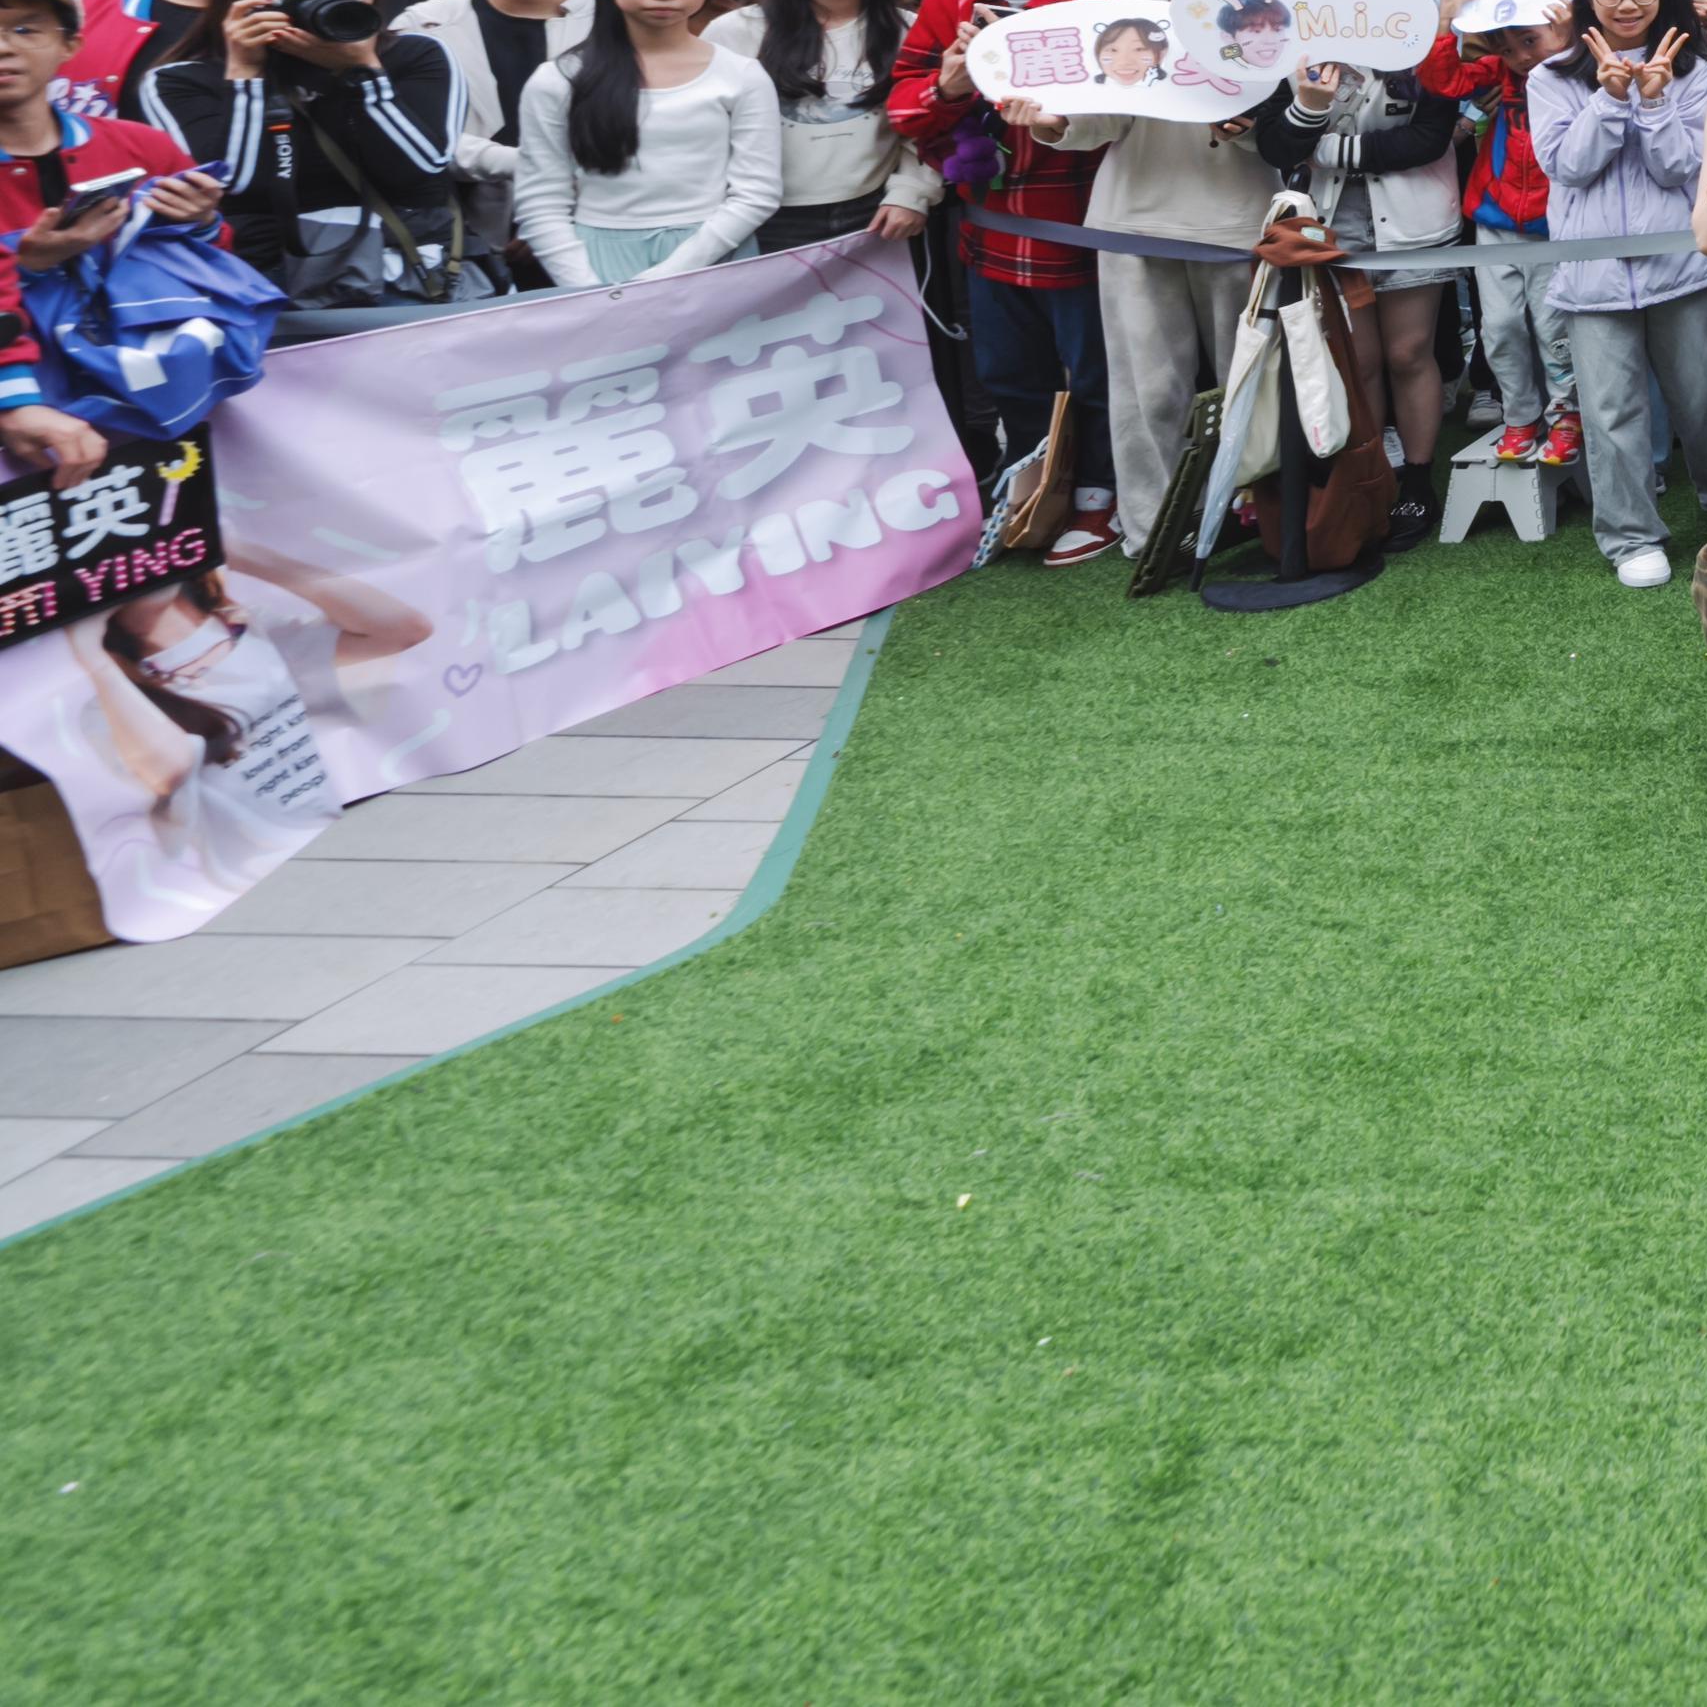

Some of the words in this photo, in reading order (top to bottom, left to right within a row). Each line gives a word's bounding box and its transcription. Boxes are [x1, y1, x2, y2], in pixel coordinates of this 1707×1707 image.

[1008, 27, 1089, 89] 麗
[274, 134, 293, 179] SONY
[433, 292, 915, 576] 麗英
[74, 527, 206, 602] YING
